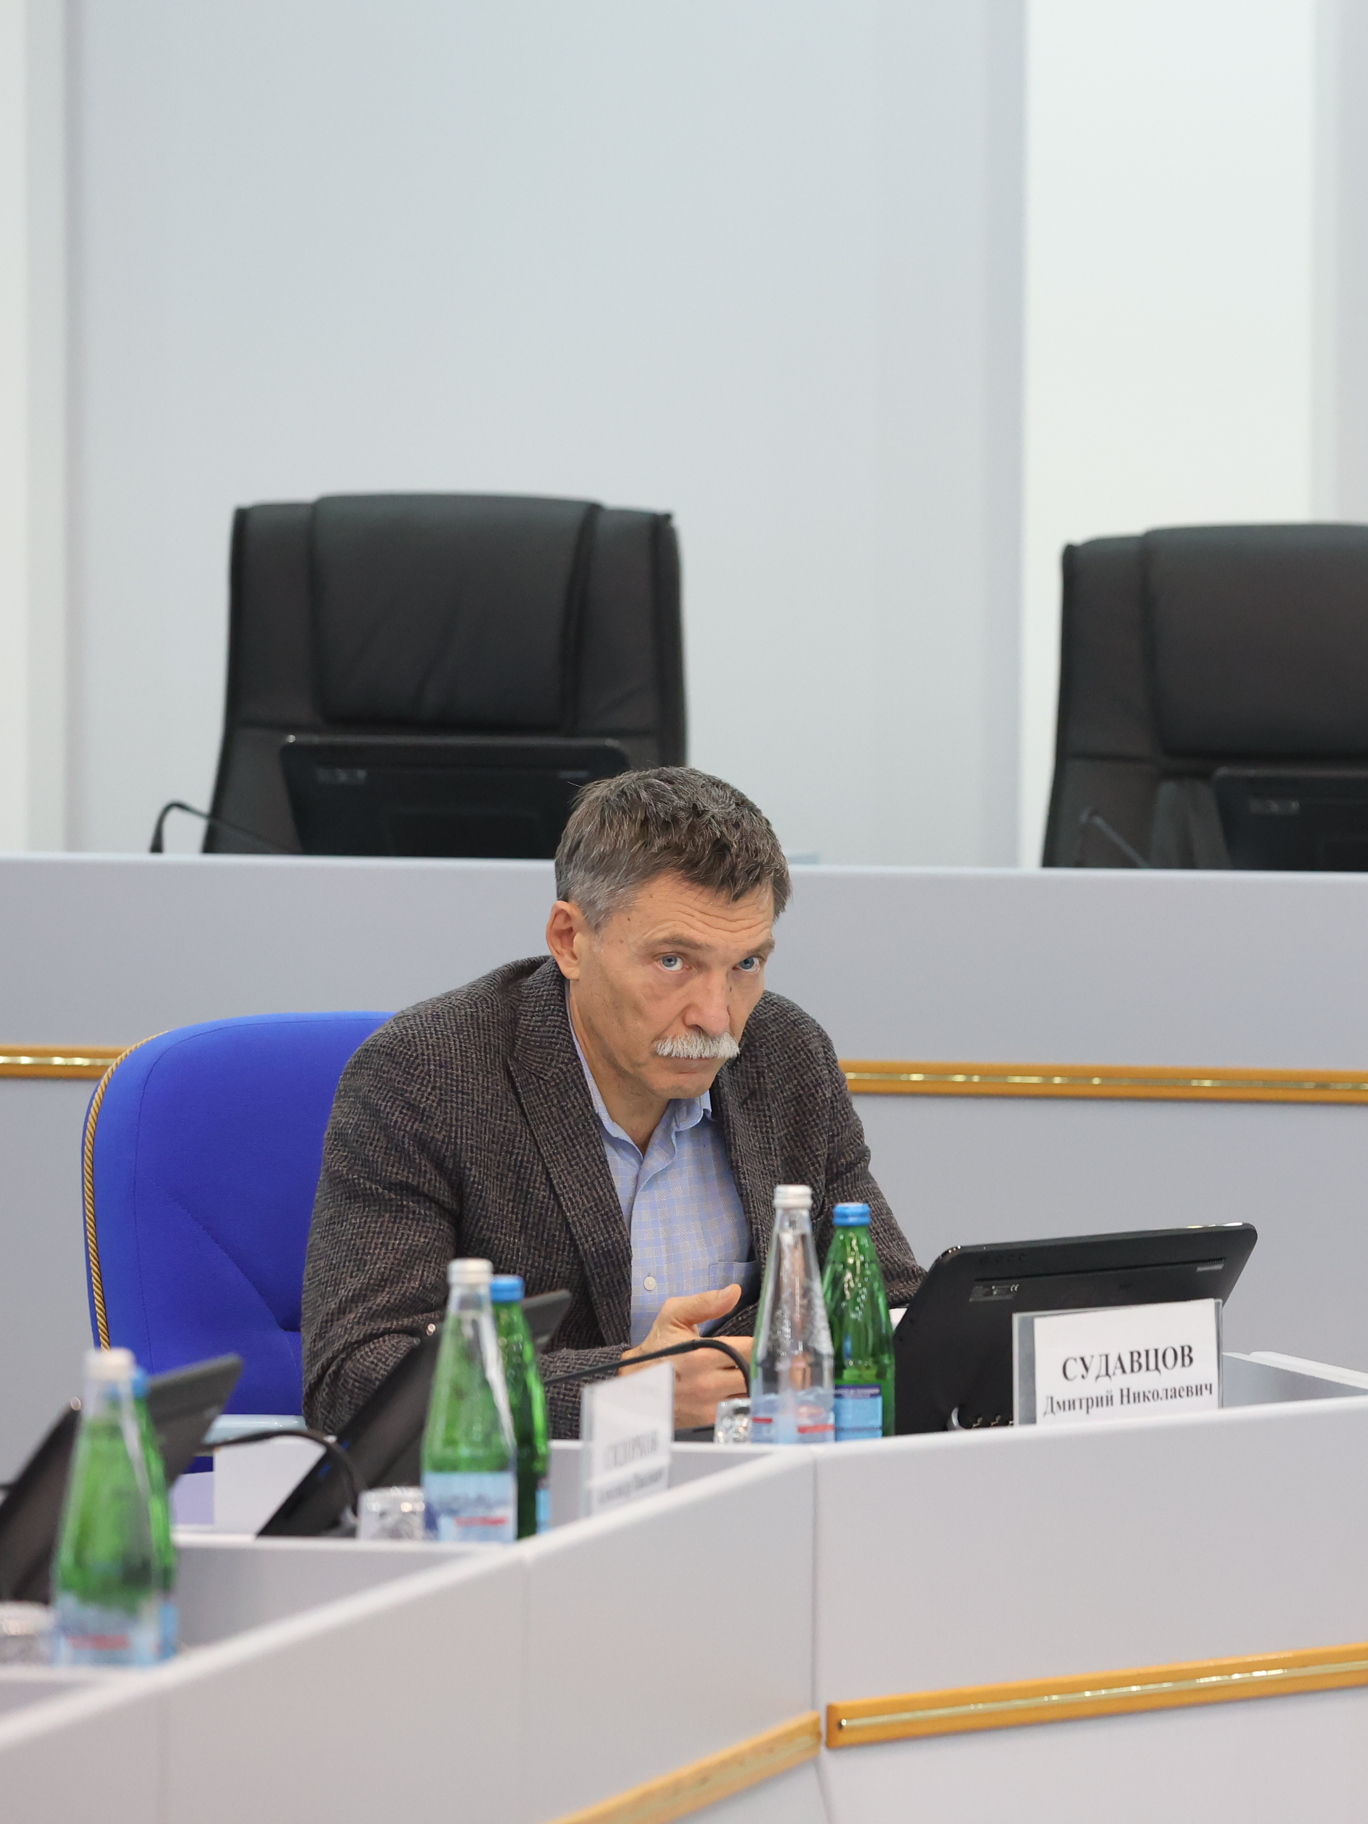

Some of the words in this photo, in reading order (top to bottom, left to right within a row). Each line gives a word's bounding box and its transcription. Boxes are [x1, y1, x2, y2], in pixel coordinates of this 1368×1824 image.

[1062, 1344, 1194, 1382] СУДАВЦОВ
[1042, 1389, 1114, 1418] Дмитрий
[1120, 1383, 1213, 1406] Николаевич
